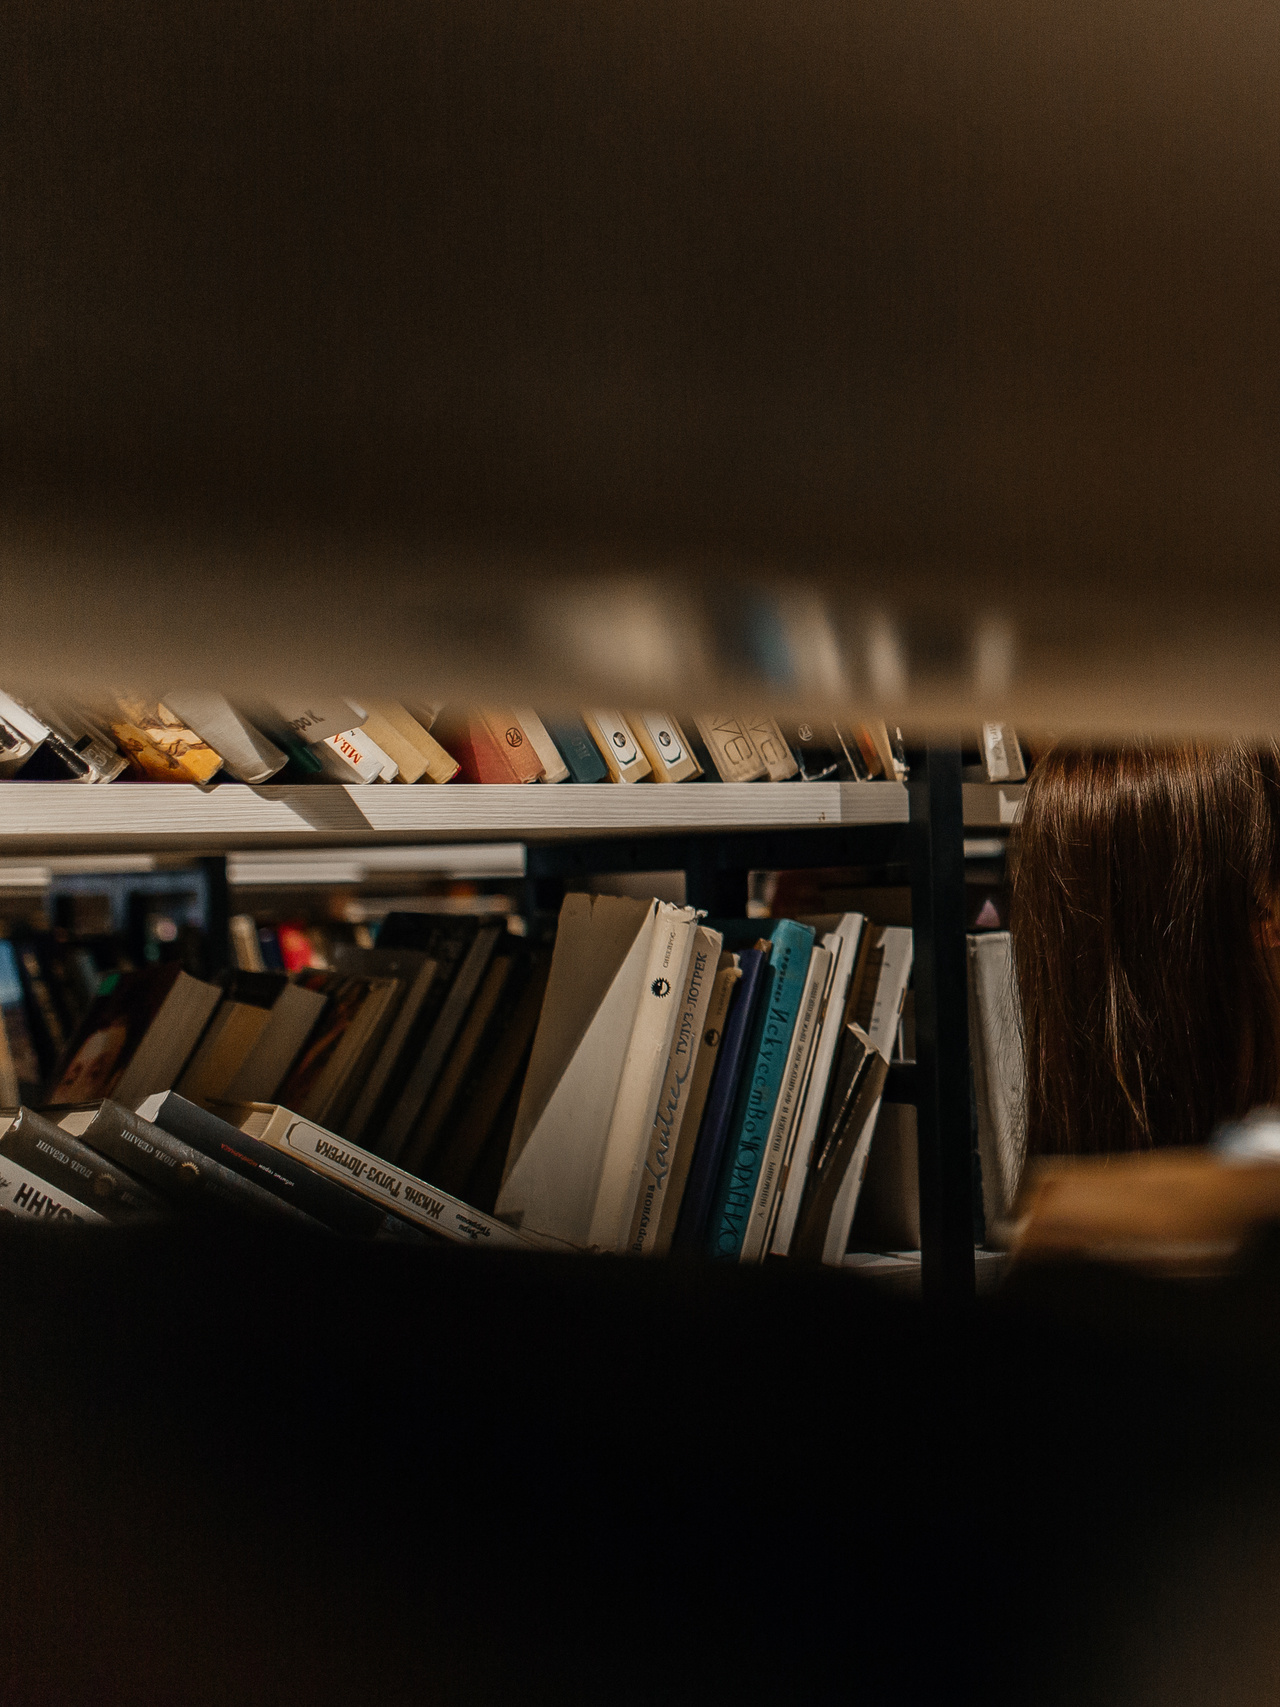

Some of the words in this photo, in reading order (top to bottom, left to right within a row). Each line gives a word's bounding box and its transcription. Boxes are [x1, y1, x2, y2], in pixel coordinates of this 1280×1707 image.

[675, 951, 708, 1055] ТУЛУЗ-ЛОТРЕК
[34, 1138, 70, 1165] СЕЗАНН
[119, 1127, 155, 1155] СЕЗАНН
[68, 1158, 93, 1179] ПОЛЬ
[152, 1147, 177, 1168] ПОЛЬ
